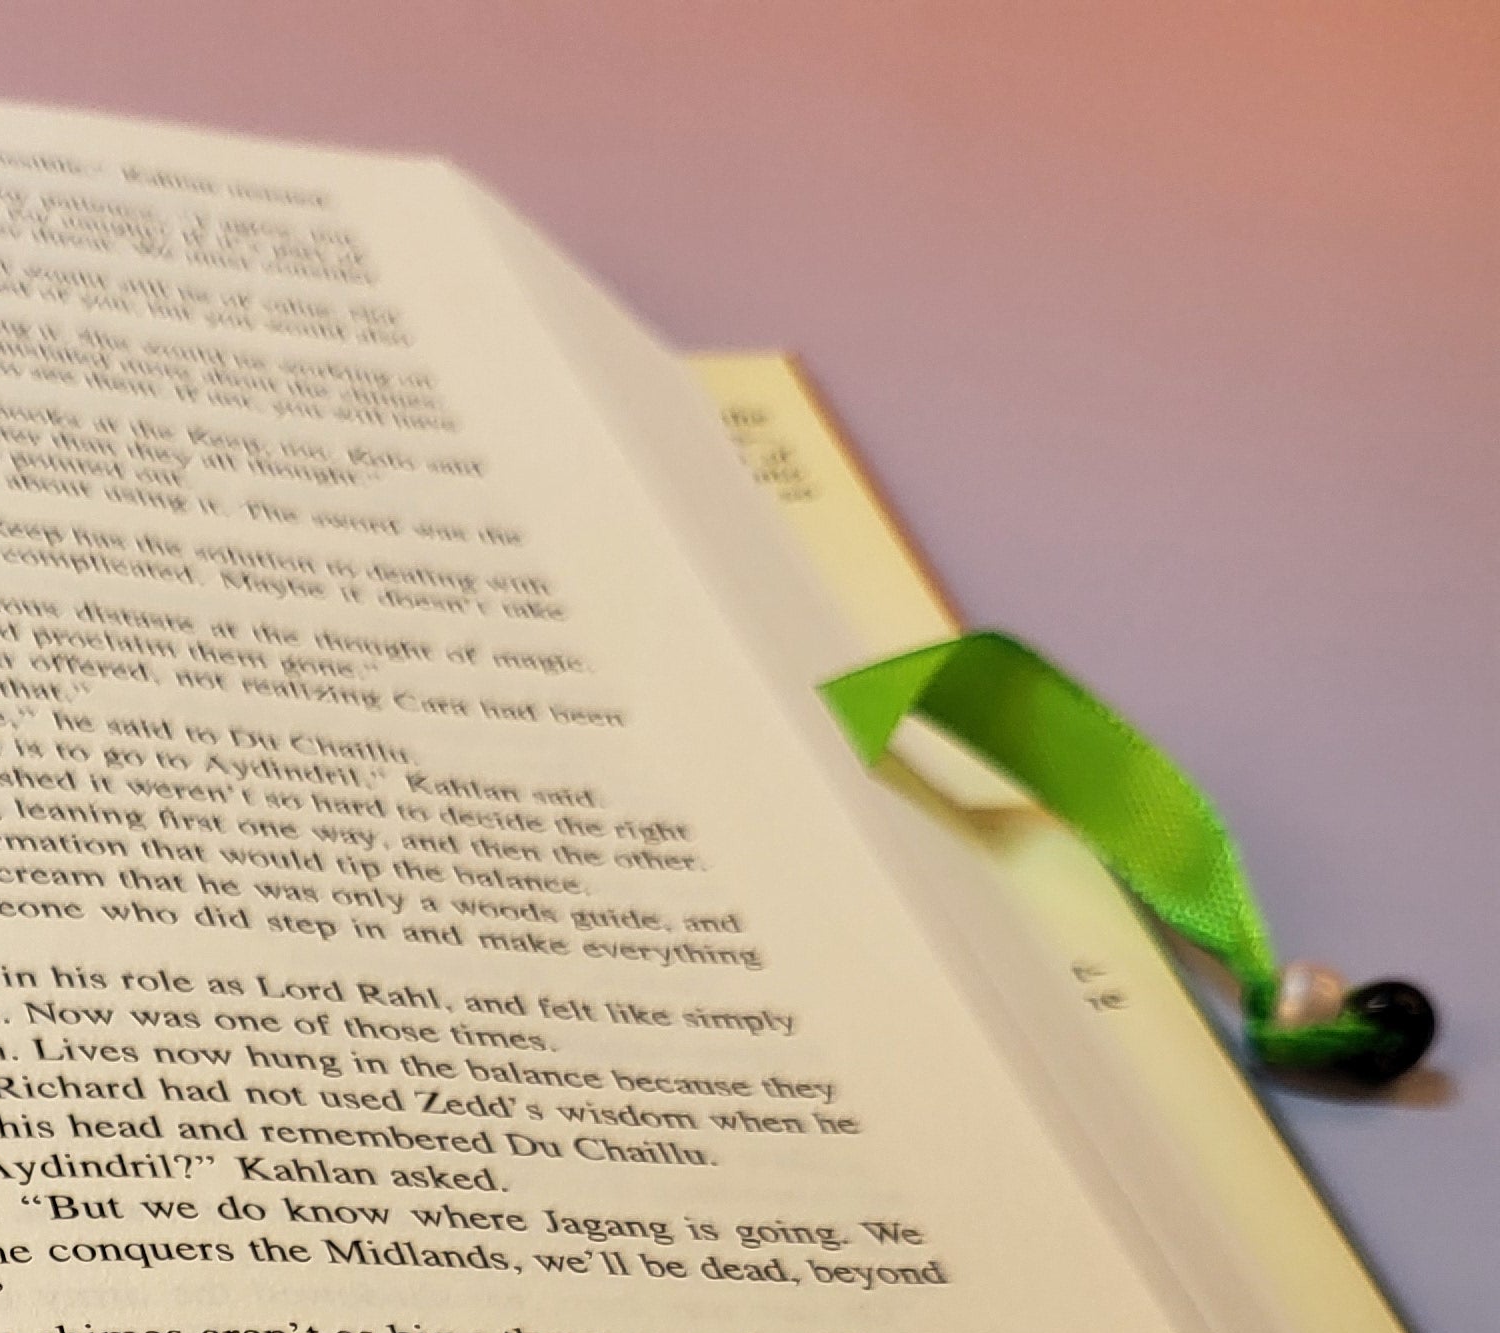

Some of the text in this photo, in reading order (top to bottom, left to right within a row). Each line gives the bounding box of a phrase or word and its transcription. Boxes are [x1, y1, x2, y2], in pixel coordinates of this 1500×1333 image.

[23, 1001, 114, 1026] Now
[129, 1009, 201, 1029] was
[214, 1012, 283, 1033] one
[294, 1013, 329, 1036] of
[344, 1016, 441, 1043] those
[450, 1022, 560, 1053] times.
[234, 1155, 378, 1186] Kahlan
[390, 1164, 510, 1193] asked.
